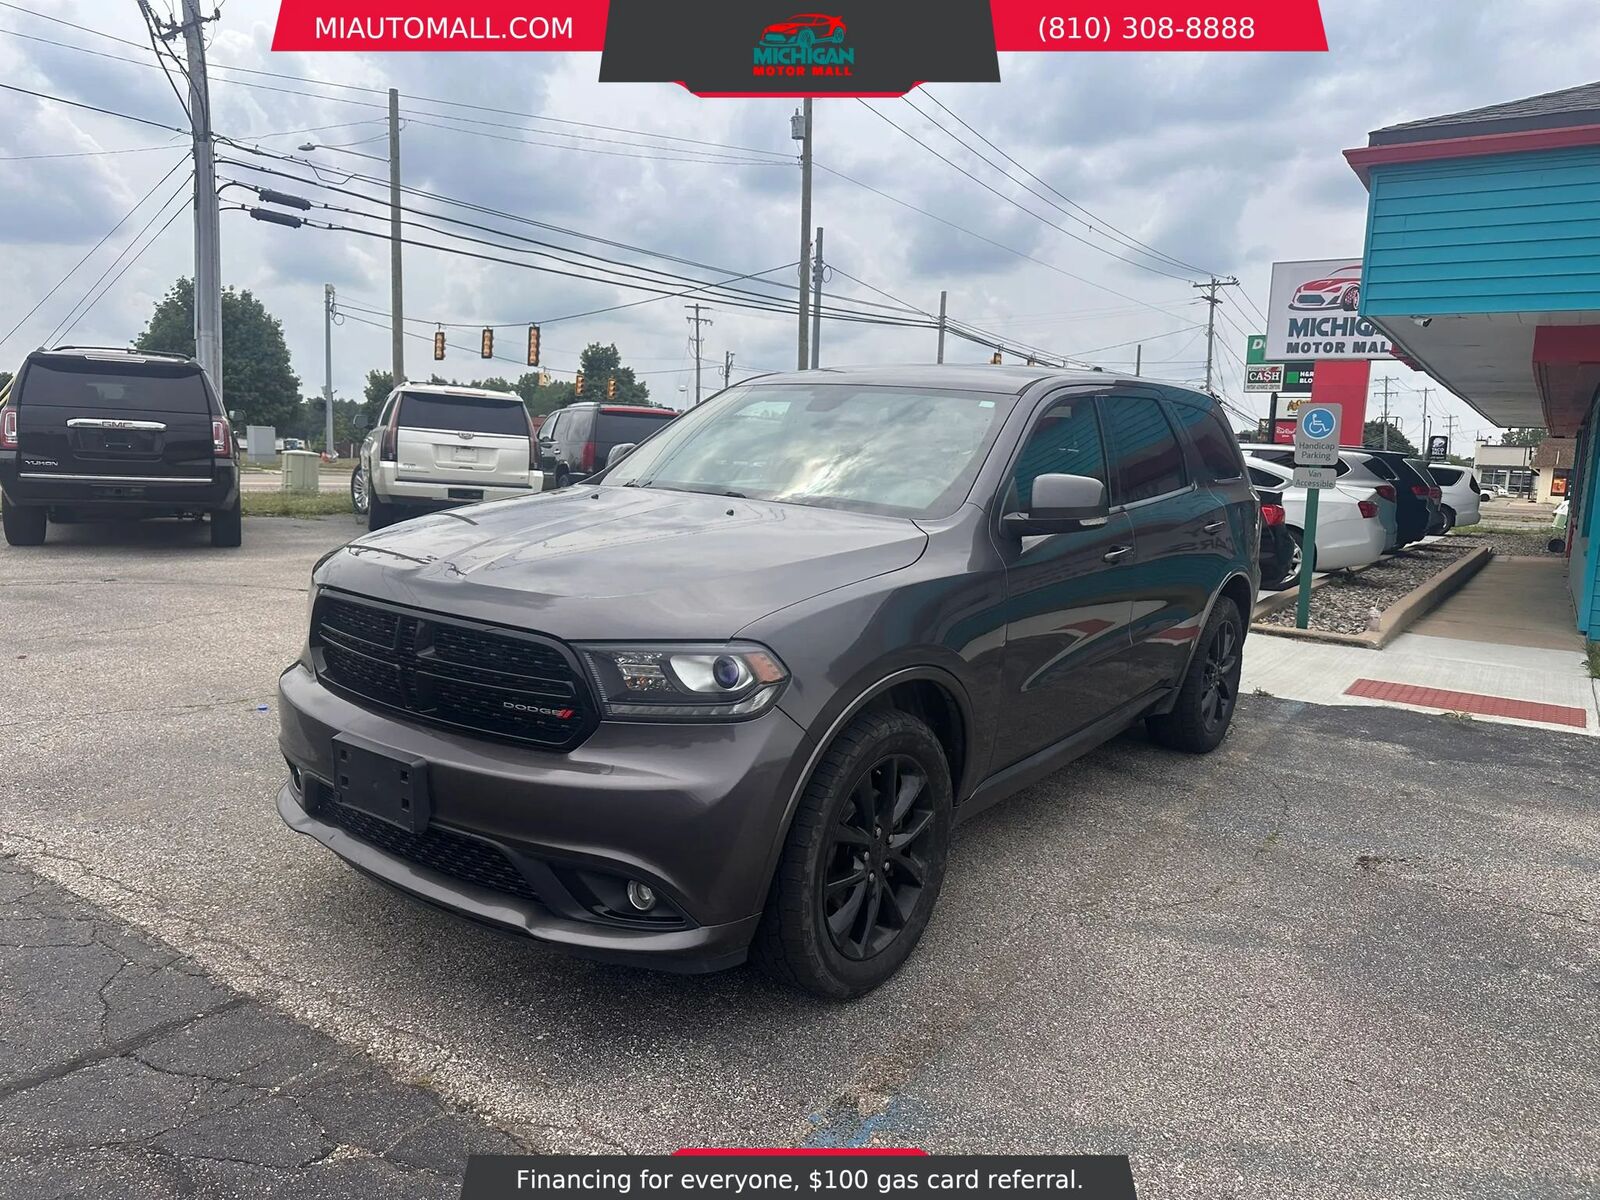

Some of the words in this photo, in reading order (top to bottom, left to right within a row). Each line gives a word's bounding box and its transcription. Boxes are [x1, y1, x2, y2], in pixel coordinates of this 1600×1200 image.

[1287, 317, 1382, 338] MICHIG
[1286, 341, 1345, 354] MOTOR
[1299, 442, 1335, 452] Handicap
[1301, 451, 1331, 461] Parking
[1295, 479, 1334, 487] Accessible
[503, 702, 562, 716] DODGE
